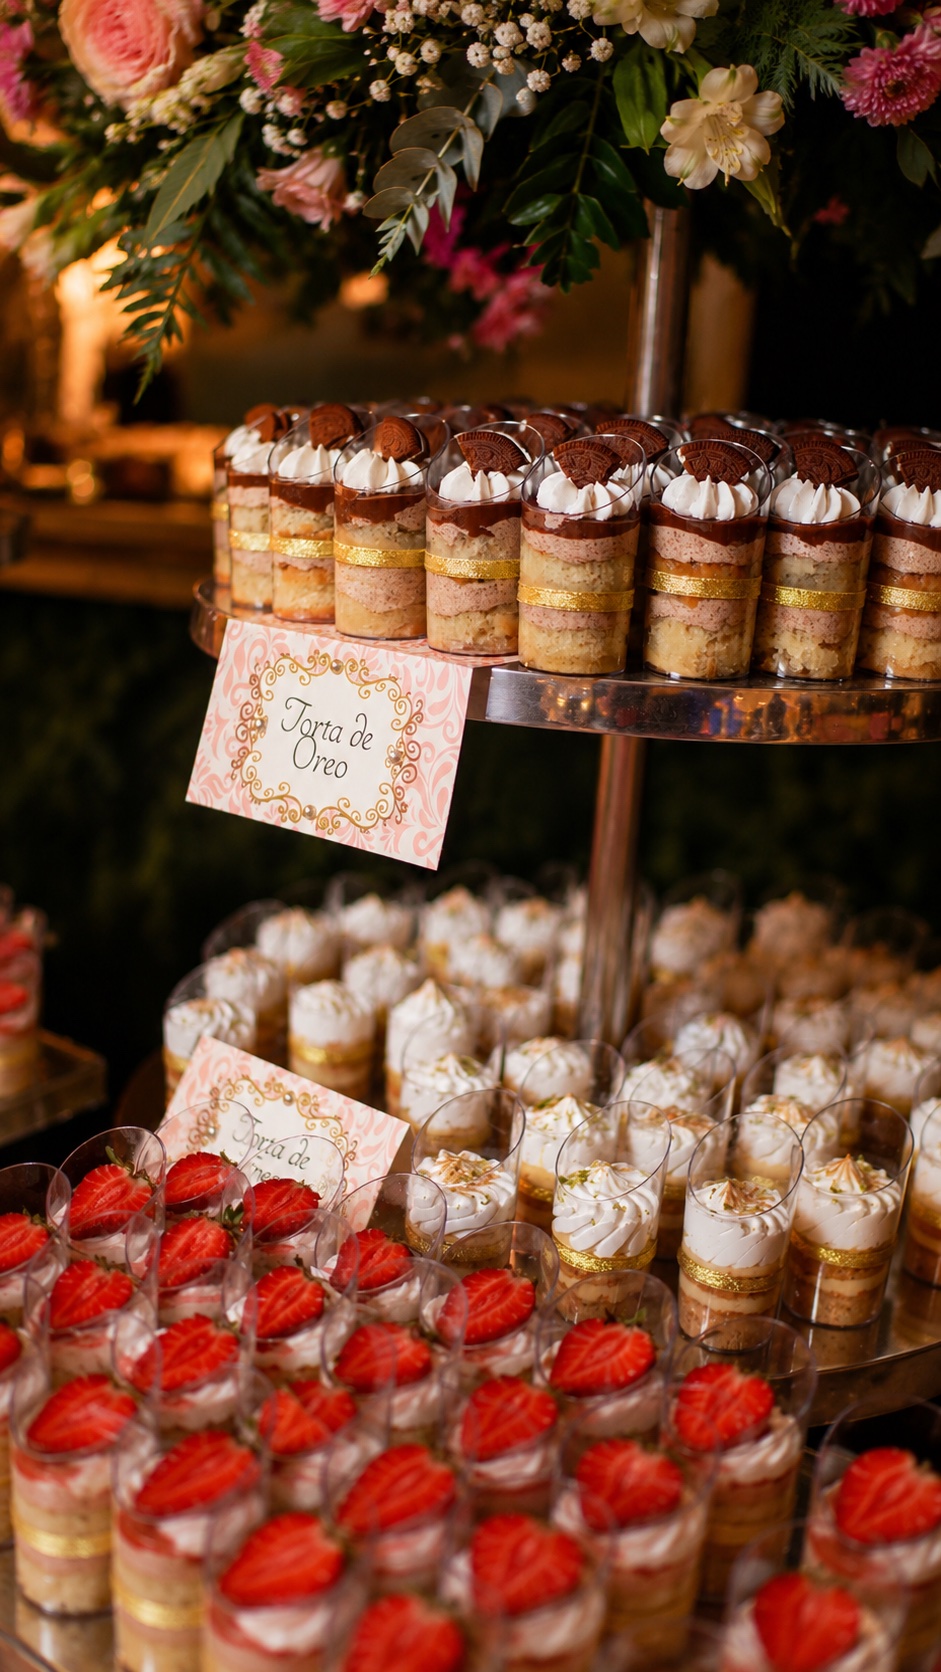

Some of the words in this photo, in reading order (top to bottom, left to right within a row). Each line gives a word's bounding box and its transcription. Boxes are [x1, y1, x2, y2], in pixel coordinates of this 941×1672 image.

[281, 697, 343, 744] Torta
[349, 712, 373, 750] de
[293, 735, 348, 779] Oreo
[288, 1138, 311, 1170] de
